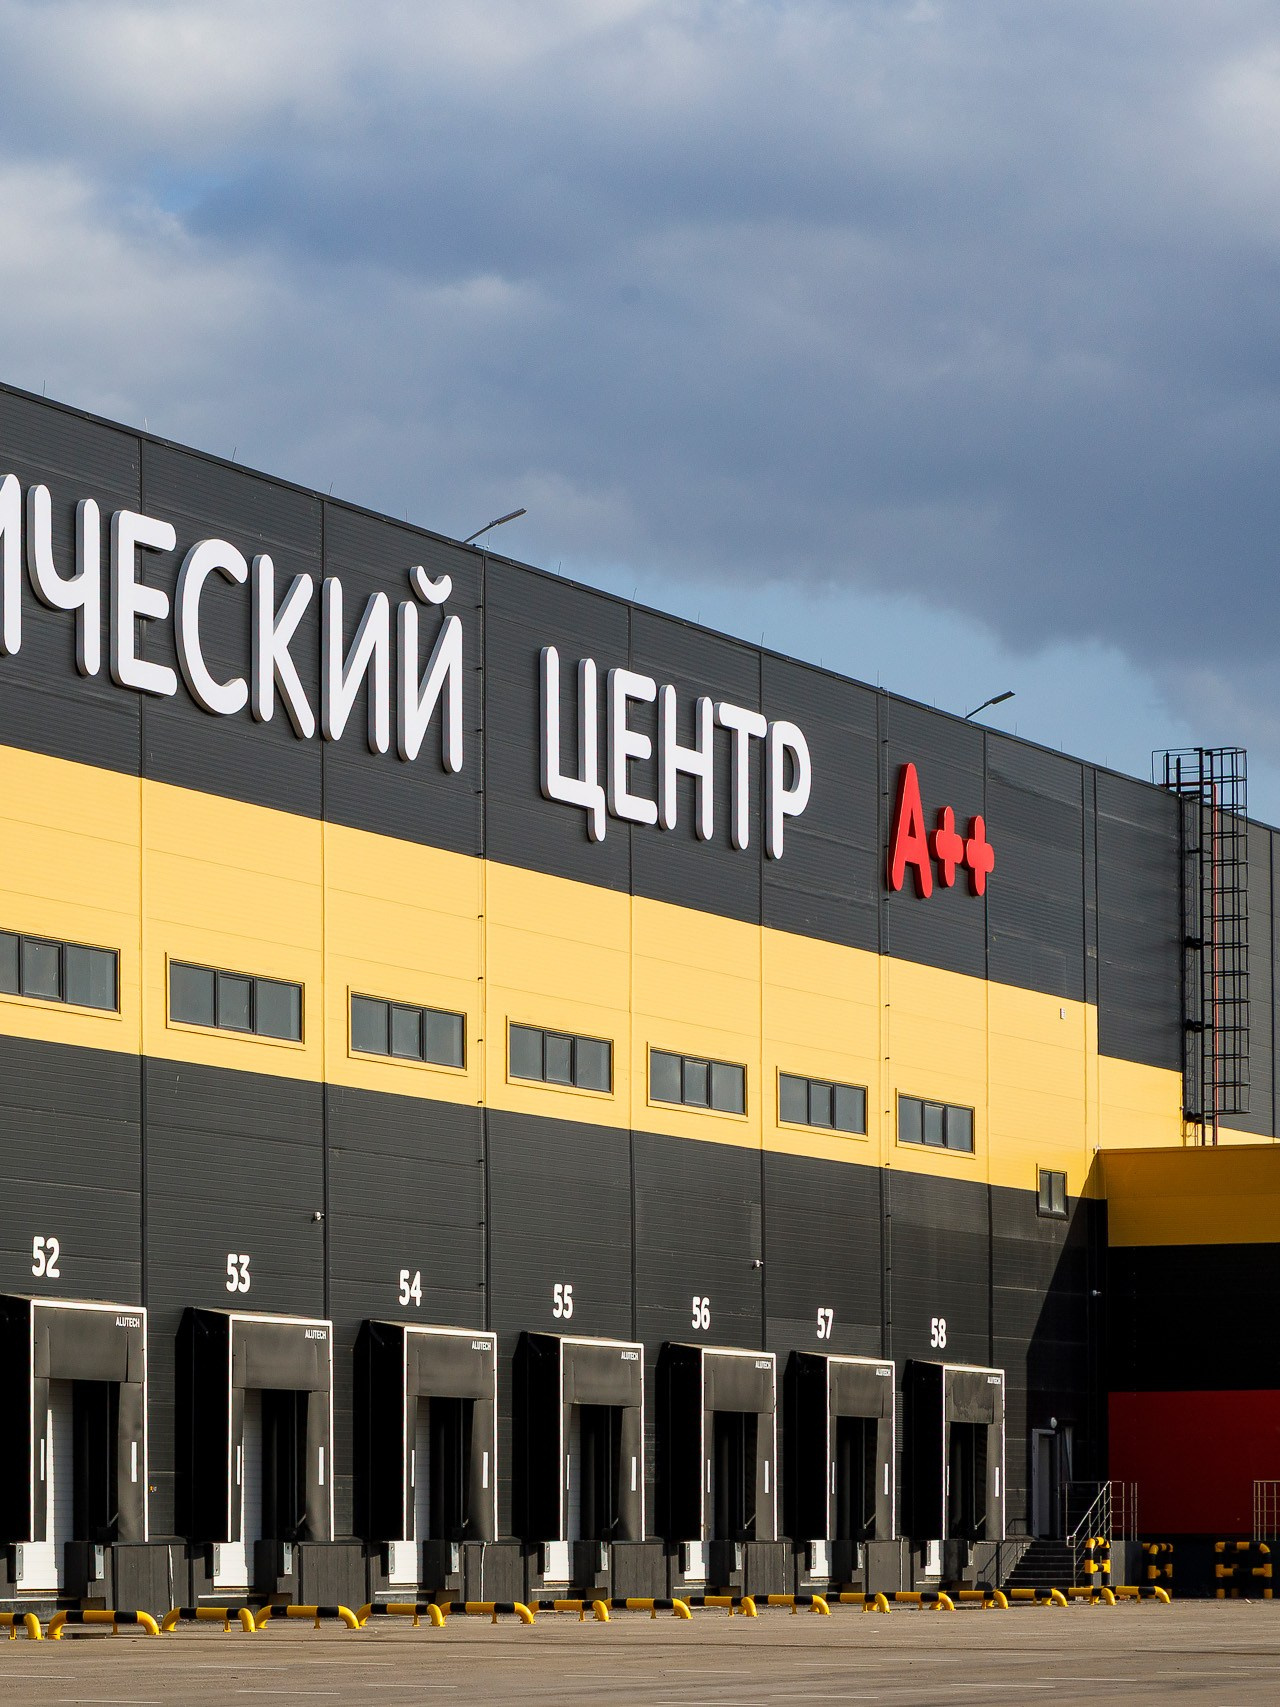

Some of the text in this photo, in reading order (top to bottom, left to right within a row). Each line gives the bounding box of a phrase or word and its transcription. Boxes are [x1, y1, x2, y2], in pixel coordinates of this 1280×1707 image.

[540, 646, 812, 860] ЦЕНТР
[32, 1236, 60, 1278] 52
[226, 1254, 250, 1293] 53
[398, 1269, 422, 1306] 54
[553, 1284, 573, 1319] 55
[692, 1297, 710, 1330] 56
[116, 1317, 140, 1327] ALUTECH
[305, 1329, 326, 1339] ALUTECH
[817, 1308, 833, 1339] 57
[931, 1318, 946, 1348] 58
[472, 1339, 492, 1350] ALUTECH
[621, 1351, 638, 1360] ALUTECH
[756, 1359, 772, 1369] ALUTECH
